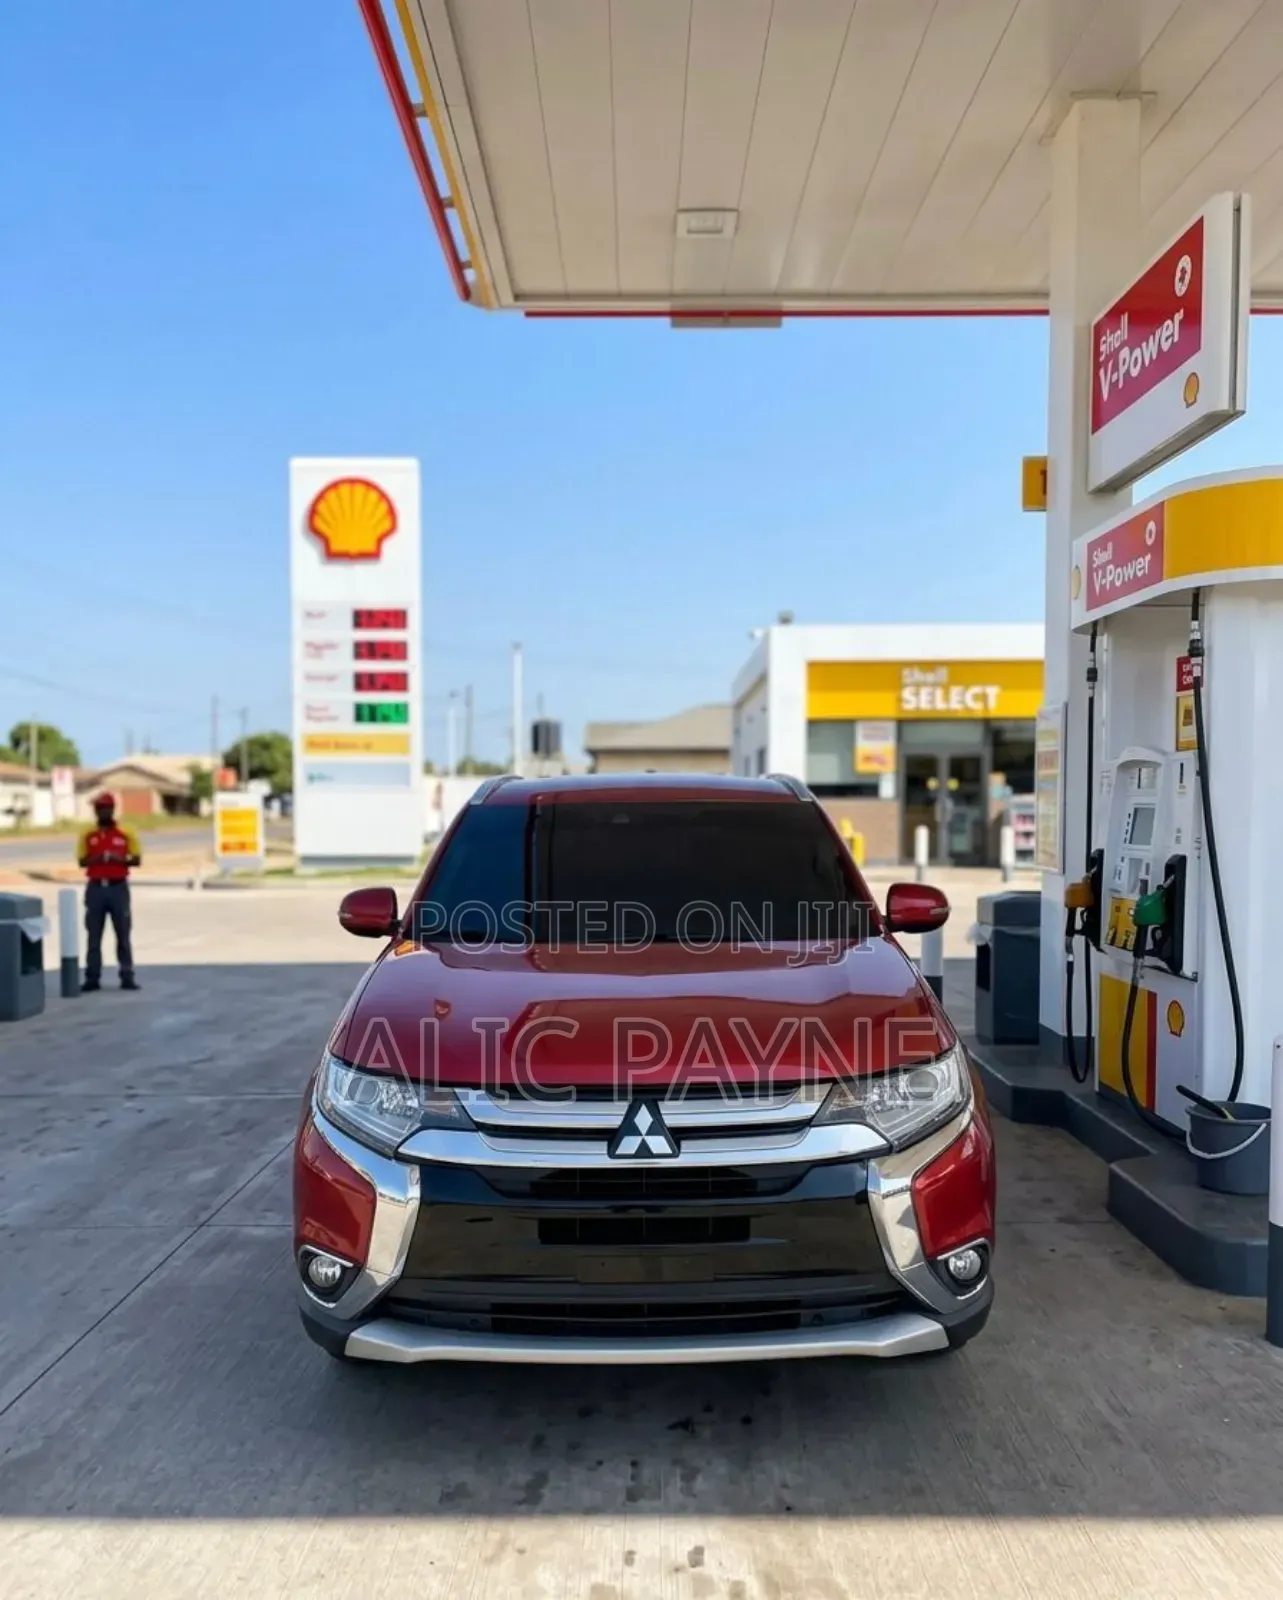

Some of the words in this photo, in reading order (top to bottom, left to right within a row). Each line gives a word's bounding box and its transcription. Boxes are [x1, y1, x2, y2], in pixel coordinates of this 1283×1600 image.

[1099, 307, 1184, 402] V-Power
[1092, 553, 1151, 597] V-Power
[901, 685, 1001, 711] SELECT
